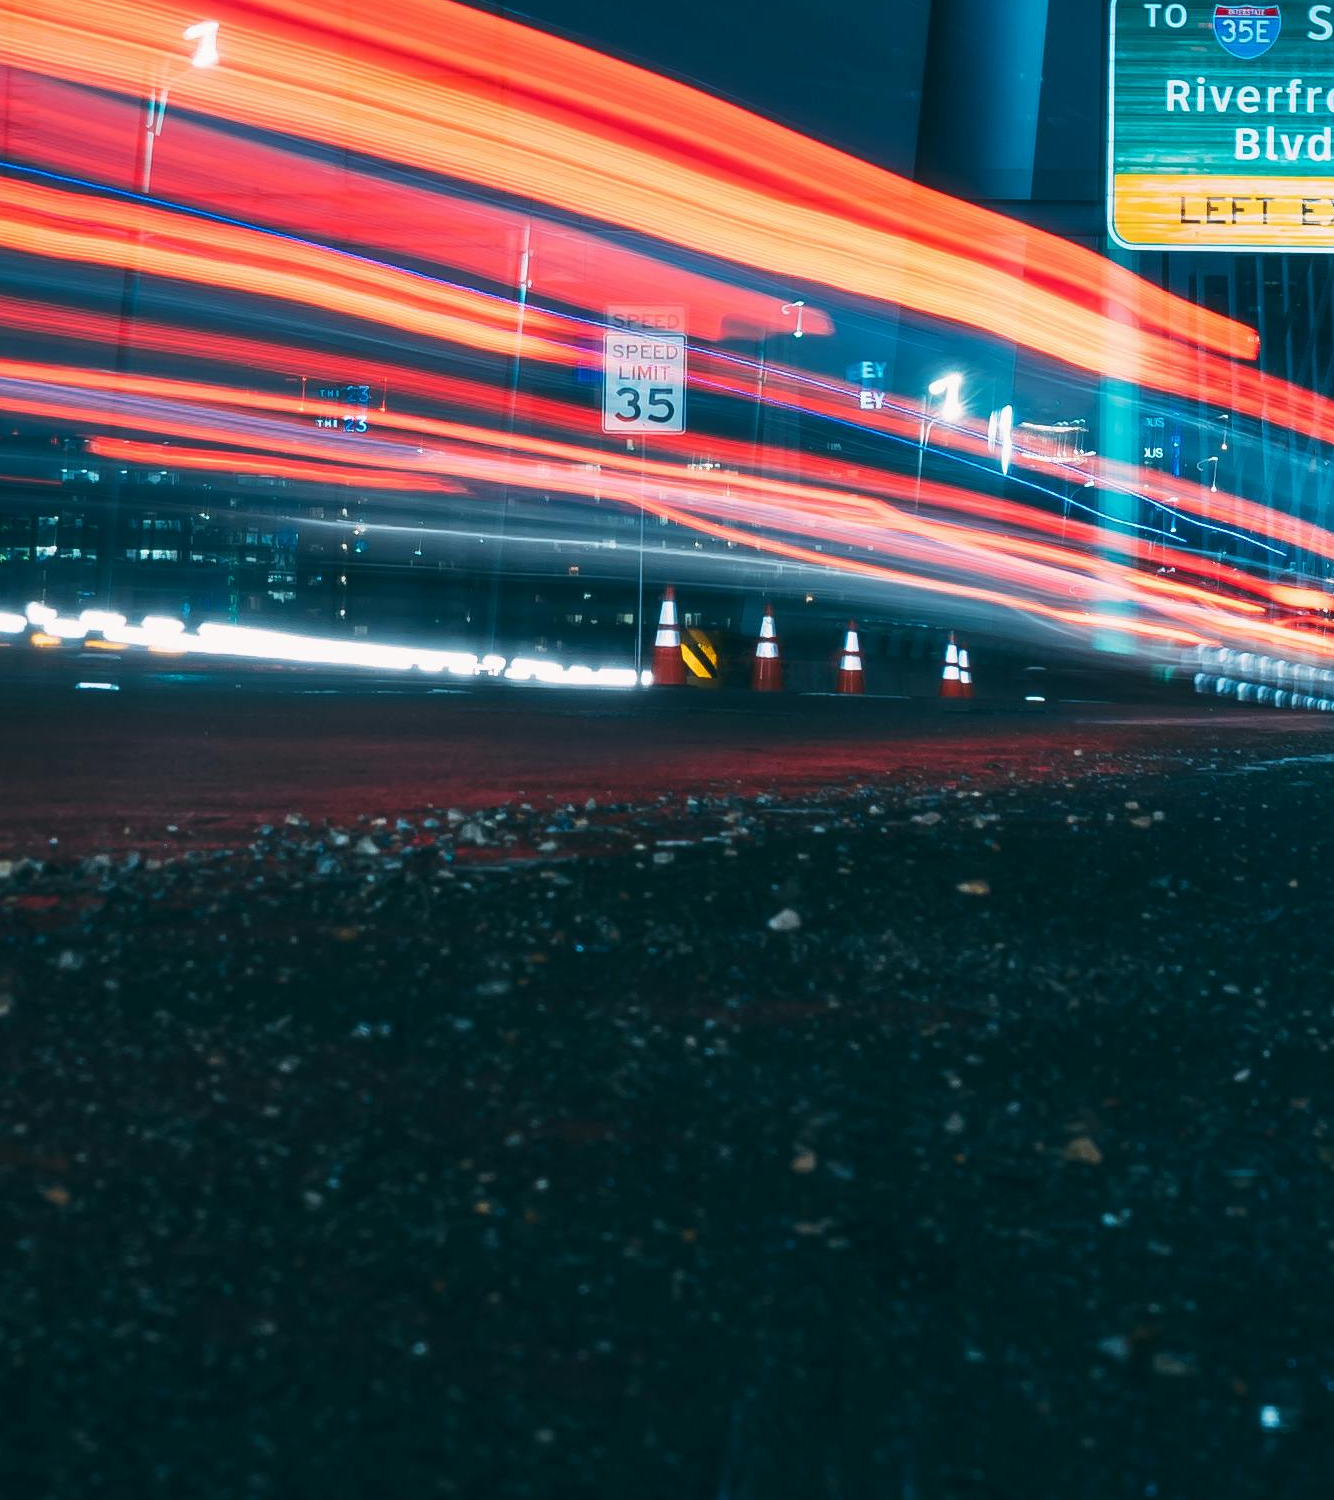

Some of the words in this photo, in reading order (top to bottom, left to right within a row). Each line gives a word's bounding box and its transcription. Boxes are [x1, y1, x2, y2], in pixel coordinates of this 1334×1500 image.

[1143, 3, 1188, 29] TO
[1221, 19, 1271, 43] 35E
[1234, 126, 1332, 162] Blvd
[1179, 196, 1275, 225] LEFT
[612, 344, 679, 360] SPEED
[618, 365, 671, 381] LIMIT
[614, 387, 675, 424] 35
[859, 391, 886, 410] EY
